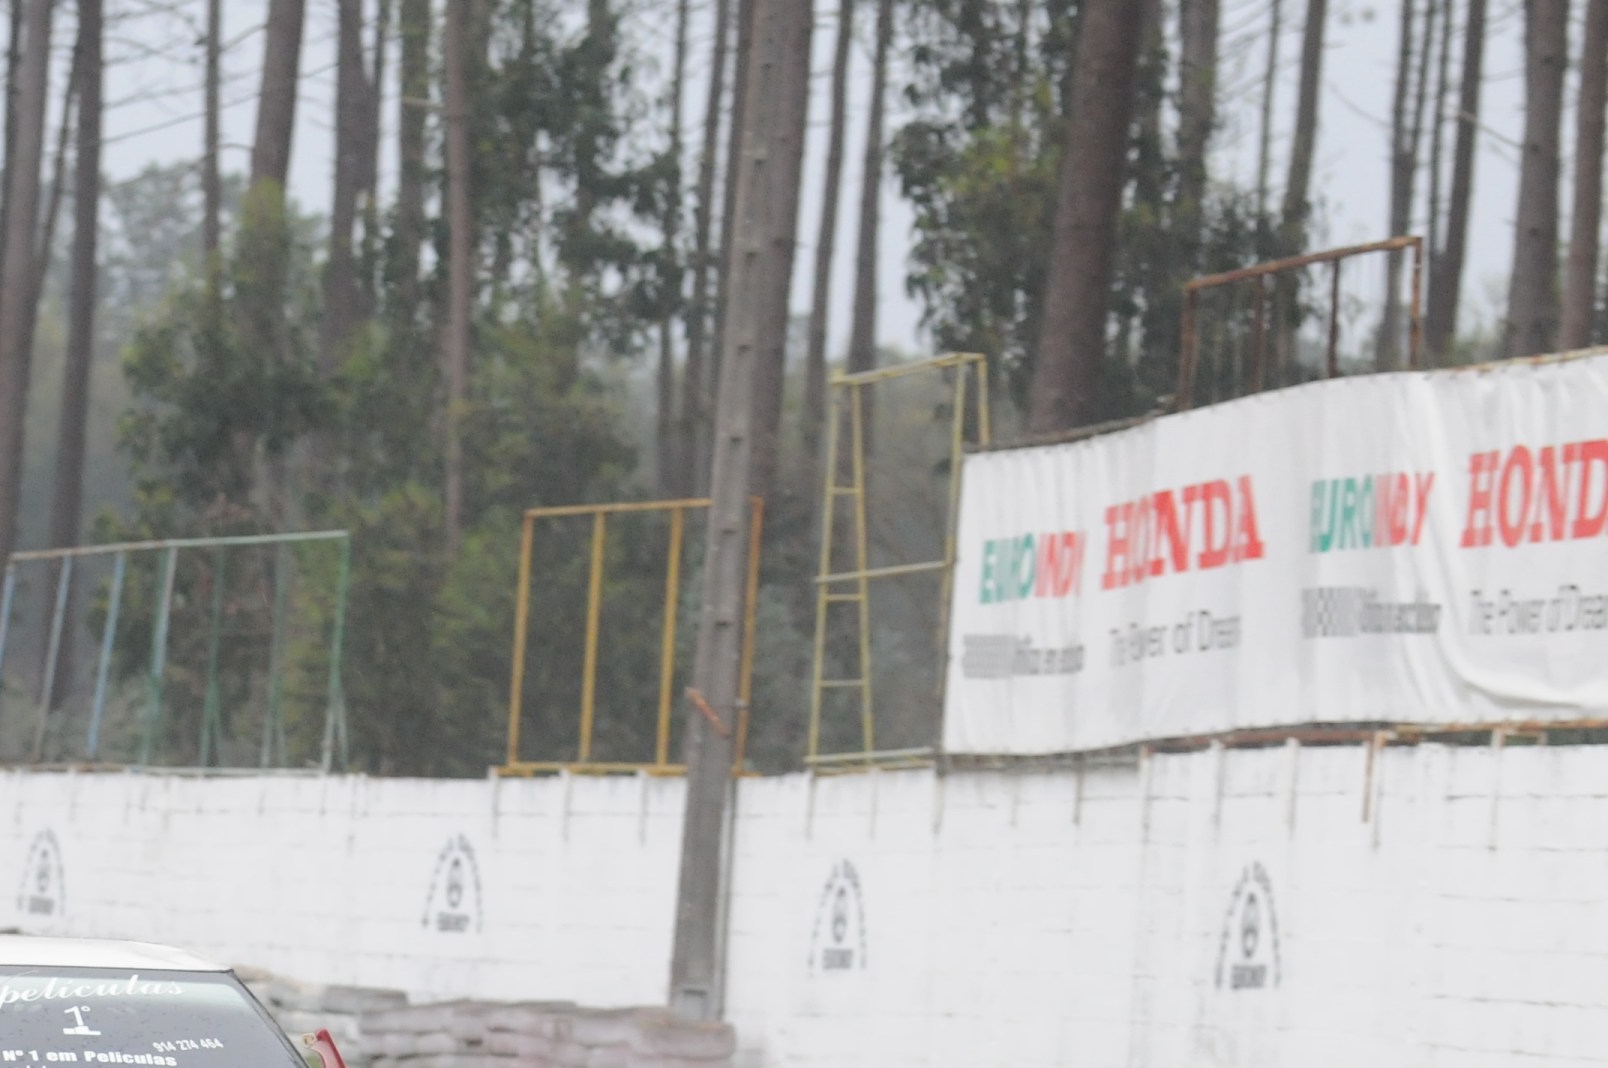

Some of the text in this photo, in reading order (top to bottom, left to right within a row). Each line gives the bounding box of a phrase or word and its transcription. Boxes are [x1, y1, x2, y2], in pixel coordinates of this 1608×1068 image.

[1100, 474, 1266, 591] HONDA
[1458, 437, 1608, 550] HOND
[29, 1050, 40, 1062] 1
[46, 1051, 78, 1062] em
